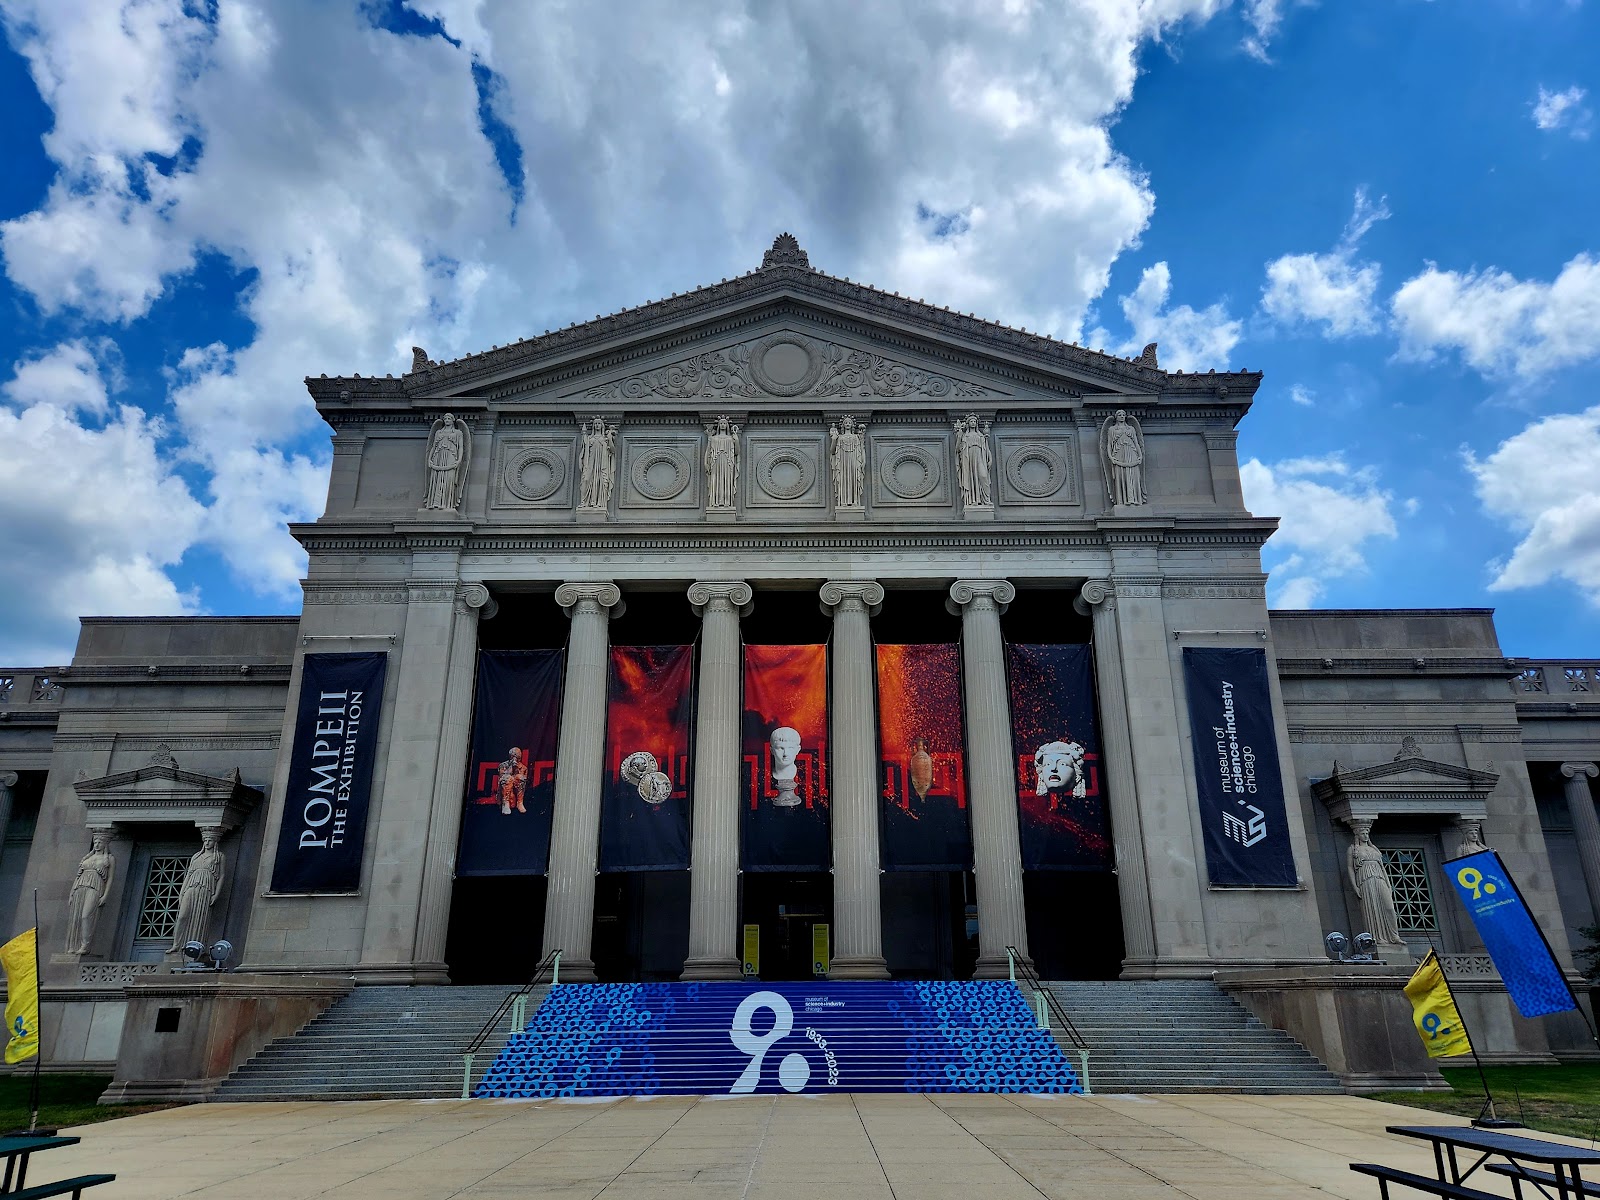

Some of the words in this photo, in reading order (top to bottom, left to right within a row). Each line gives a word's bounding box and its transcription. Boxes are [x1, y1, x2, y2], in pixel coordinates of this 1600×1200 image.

[338, 691, 364, 802] EXHIBITION
[1212, 727, 1225, 738] of
[1221, 681, 1245, 794] science+industry
[299, 689, 348, 850] POMPEII
[1216, 740, 1232, 793] museum
[1242, 746, 1258, 794] chicago
[331, 808, 347, 849] THE
[805, 1026, 839, 1086] 1933-2023
